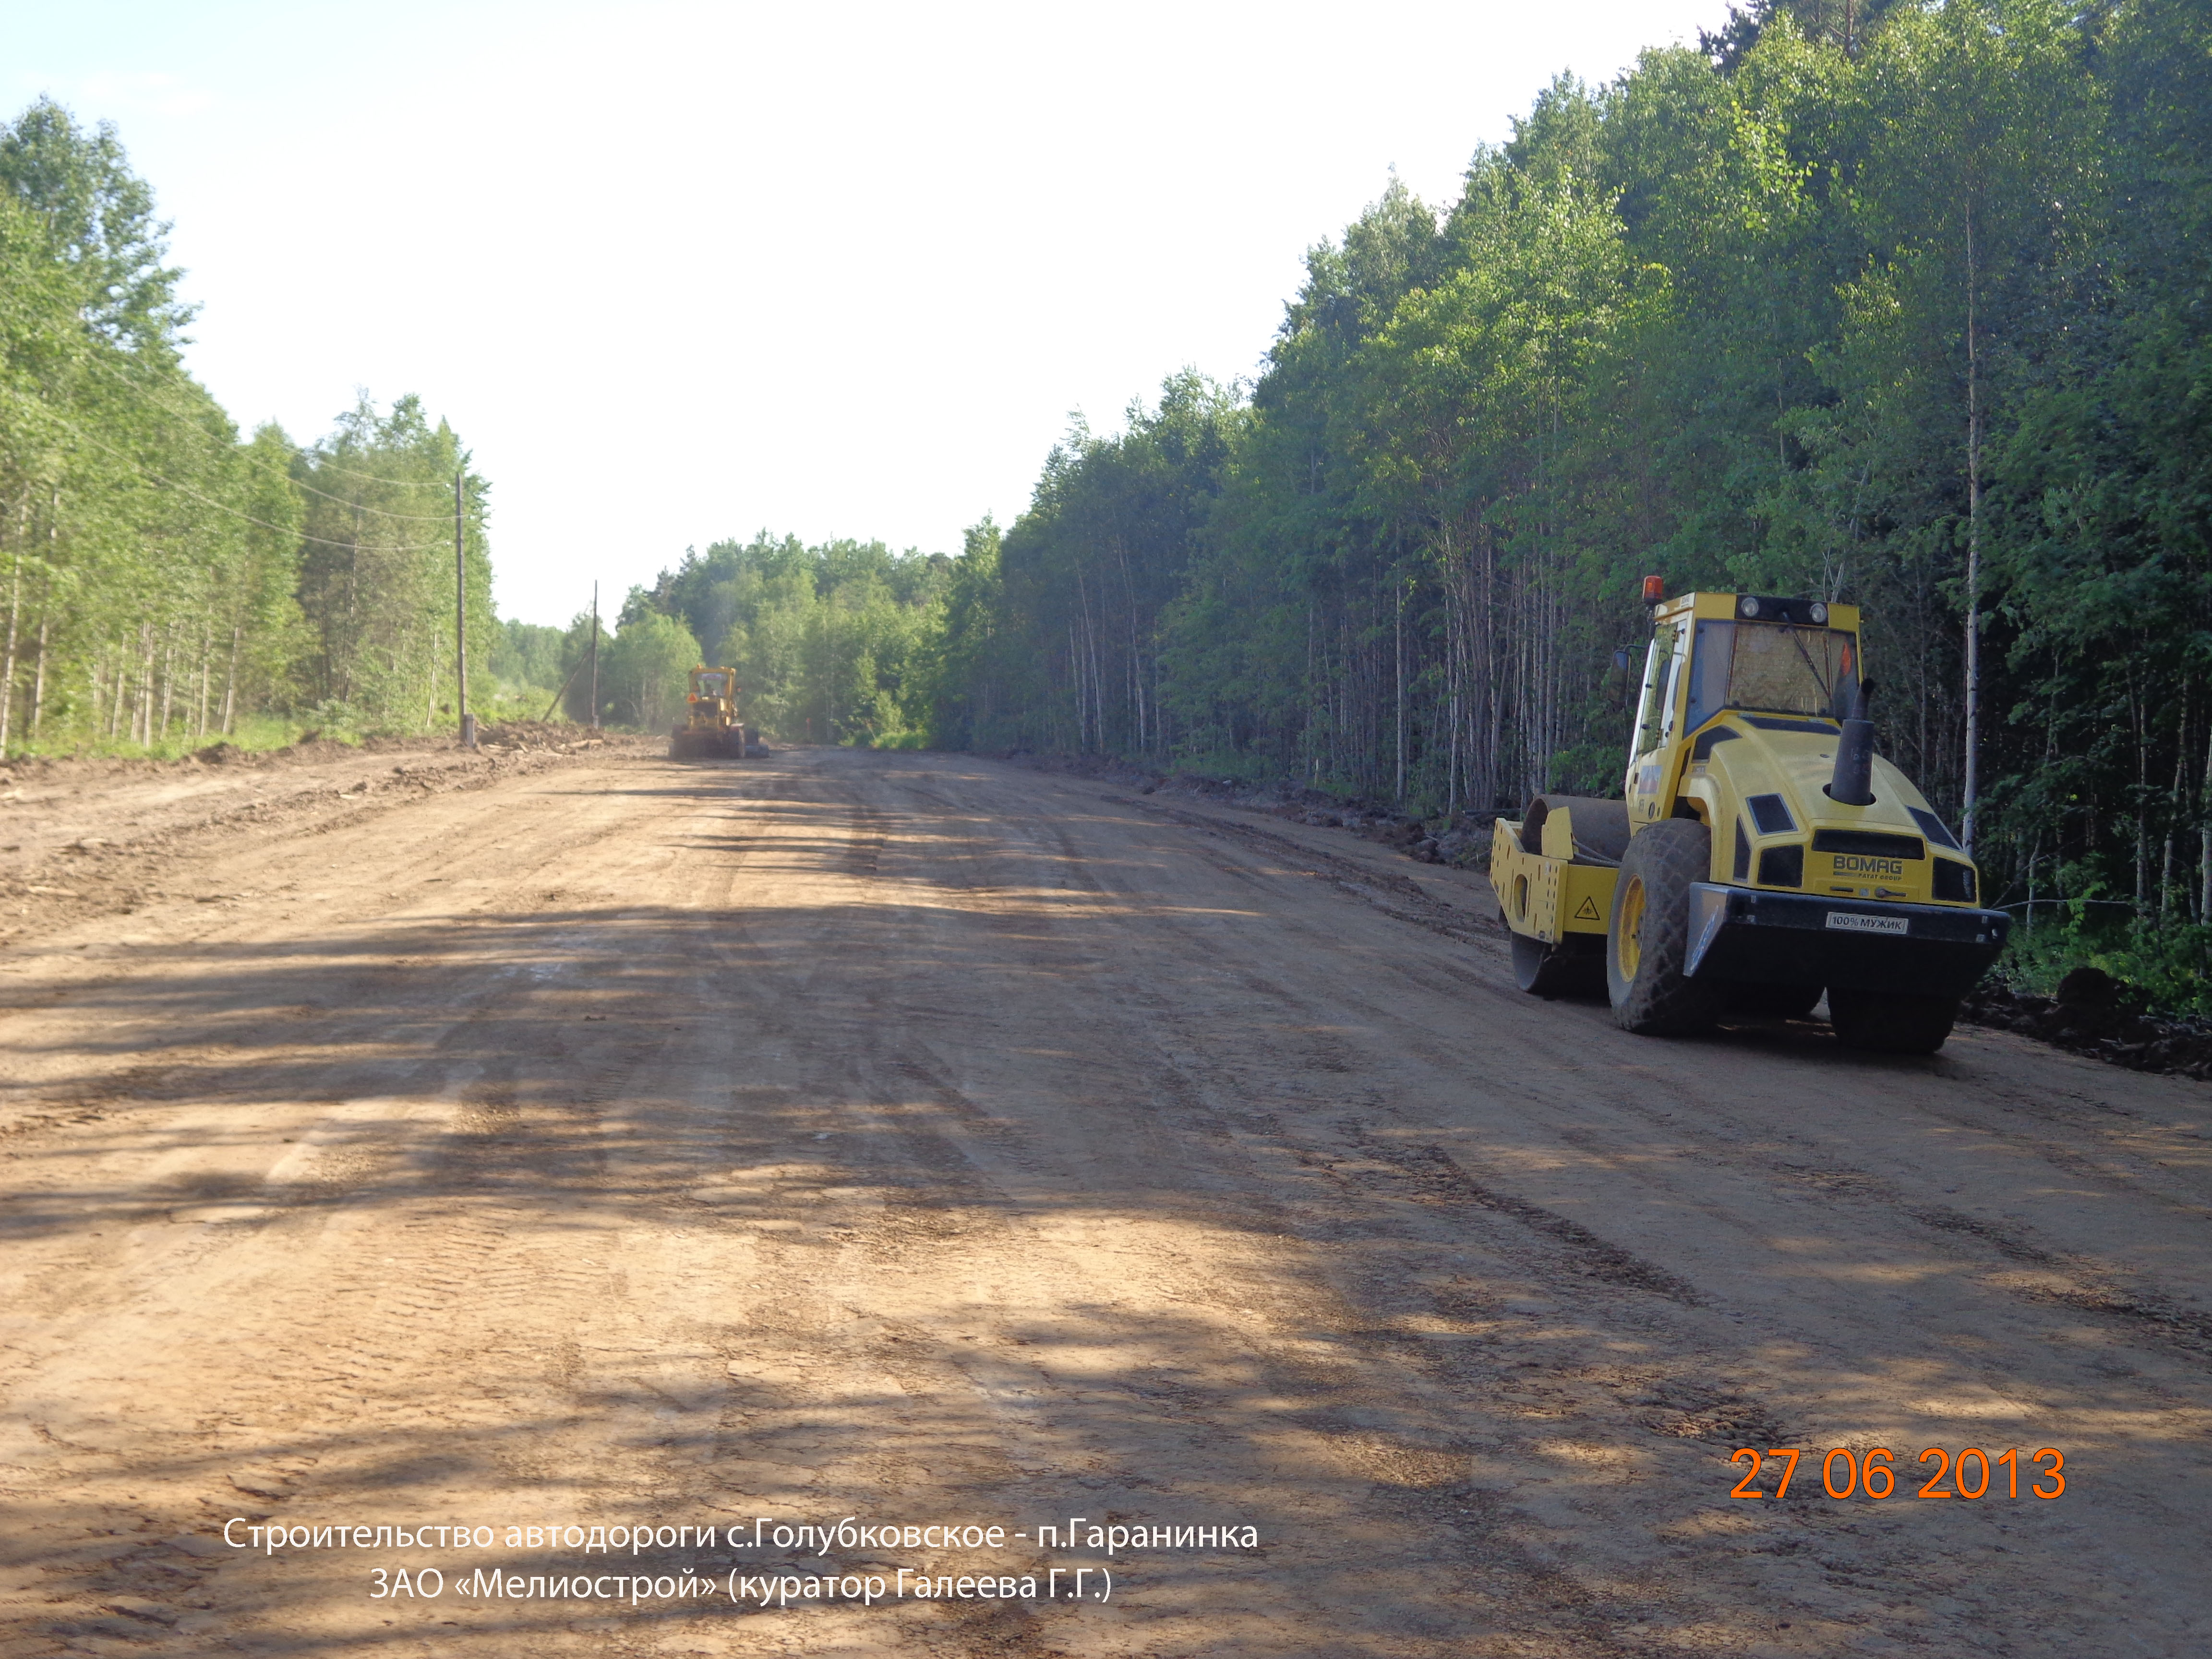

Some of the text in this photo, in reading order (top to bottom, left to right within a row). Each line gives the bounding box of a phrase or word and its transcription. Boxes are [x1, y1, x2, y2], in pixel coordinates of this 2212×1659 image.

[1833, 855, 1903, 875] BOMAG
[1833, 916, 1902, 930] 100% МУЖИК
